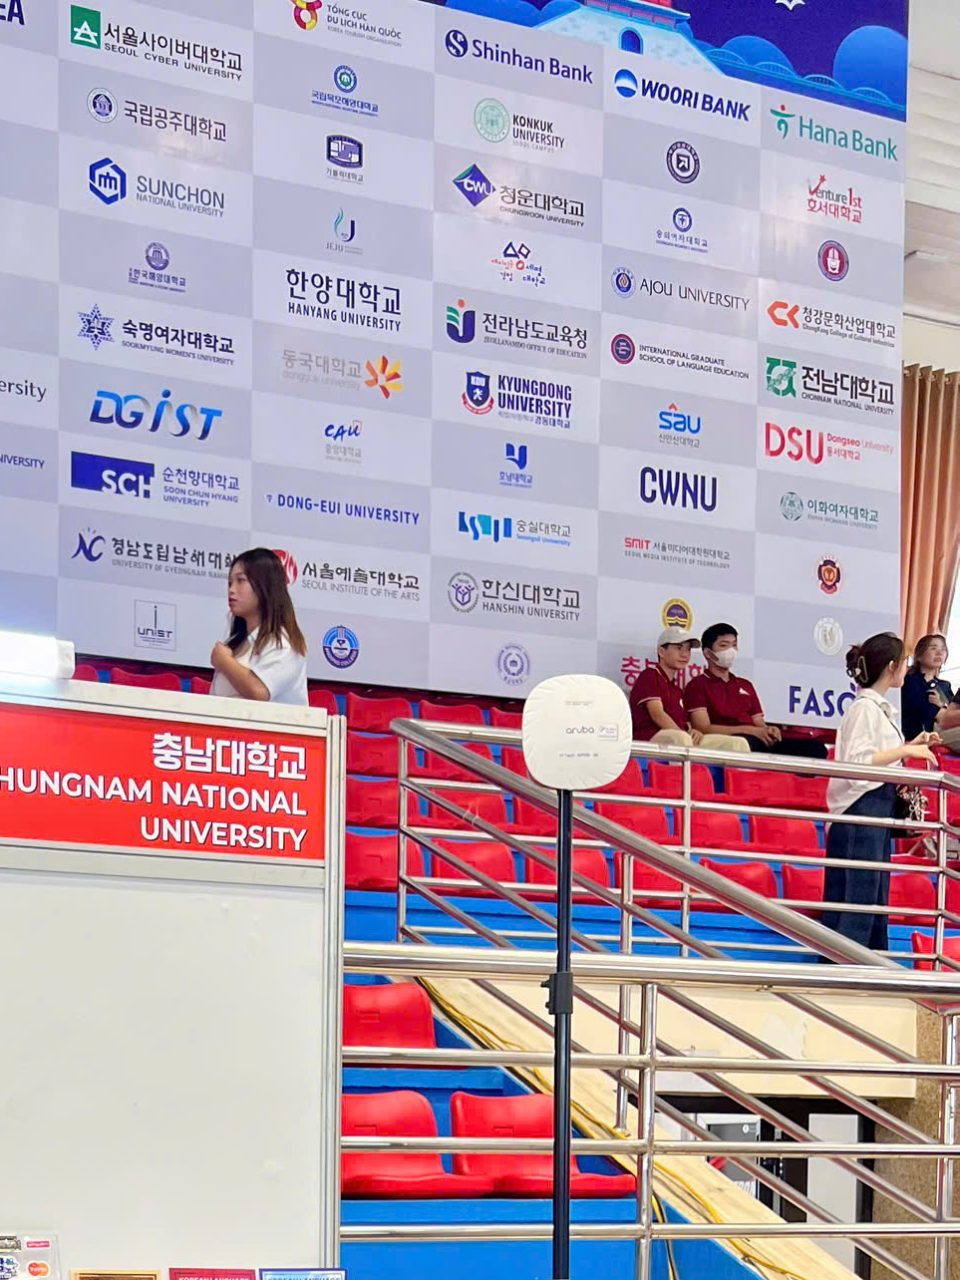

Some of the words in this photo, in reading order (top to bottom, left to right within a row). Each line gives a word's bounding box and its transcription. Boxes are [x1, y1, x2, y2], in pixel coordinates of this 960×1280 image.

[104, 23, 242, 72] 서울사이버대학교
[104, 42, 139, 58] SEOUL
[144, 52, 179, 67] CYBER
[184, 62, 242, 81] UNIVERSITY
[472, 39, 545, 73] Shinhan
[549, 58, 593, 84] Bank
[641, 78, 699, 109] WOORI
[701, 93, 751, 122] BANK
[124, 100, 227, 142] 국립공주대학교
[513, 114, 553, 133] KONKUK
[513, 127, 564, 149] UNIVERSITY
[799, 116, 848, 148] Hana
[852, 129, 898, 161] Bank
[136, 175, 225, 209] SUNCHON
[136, 193, 176, 209] NATIONAL
[178, 203, 224, 218] UNIVERSITY
[500, 185, 584, 217] 청운대학교
[500, 205, 544, 220] CHUNGWOON
[546, 214, 584, 227] UNIVERSITY
[807, 198, 862, 224] 호서대학교
[286, 268, 401, 315] 한양대학교
[640, 278, 672, 296] AJOU
[679, 285, 750, 311] UNIVERSITY
[289, 302, 337, 321] HANYANG
[341, 311, 401, 332] UNIVERSITY
[482, 313, 587, 350] 전라남도교육청
[802, 306, 896, 339] 청강문화산업대학교
[122, 319, 235, 354] 숙명여자대학교
[197, 353, 234, 366] UNIVERSITY
[282, 349, 362, 379] 동국대학교
[640, 344, 690, 360] INTERNATIONAL
[691, 354, 725, 366] GRADUATE
[640, 353, 665, 365] SCHOOL
[667, 358, 675, 366] OF
[677, 360, 712, 373] LANGUAGE
[713, 367, 749, 379] EDUCATION
[498, 374, 572, 401] KYUNGDONG
[801, 366, 894, 405] 전남대학교
[498, 392, 571, 419] UNIVERSITY
[765, 422, 824, 464] DSU
[827, 433, 860, 447] Dongseo
[162, 466, 240, 491] 순천향대학교
[640, 466, 717, 512] CWNU
[163, 486, 186, 496] SOON
[188, 488, 210, 499] CHUN
[211, 492, 238, 503] HYANG
[163, 495, 209, 508] UNIVERSITY
[278, 494, 340, 515] DONG-EUI
[345, 504, 420, 525] UNIVERSITY
[807, 499, 878, 523] 이화여자대학교
[517, 519, 571, 537] 숭실대학교
[624, 537, 651, 550] SMIT
[302, 562, 420, 590] 서울예술대학교
[302, 579, 327, 591] SEOUL
[330, 583, 368, 596] INSTITUTE
[371, 587, 382, 597] OF
[384, 589, 398, 599] THE
[400, 591, 420, 601] ARTS
[482, 579, 580, 609] 한신대학교
[483, 601, 524, 615] HANSHIN
[527, 606, 580, 621] UNIVERSITY
[152, 733, 307, 780] 충남대학교
[162, 782, 307, 816] NATIONAL
[140, 816, 307, 851] UNIVERSITY
